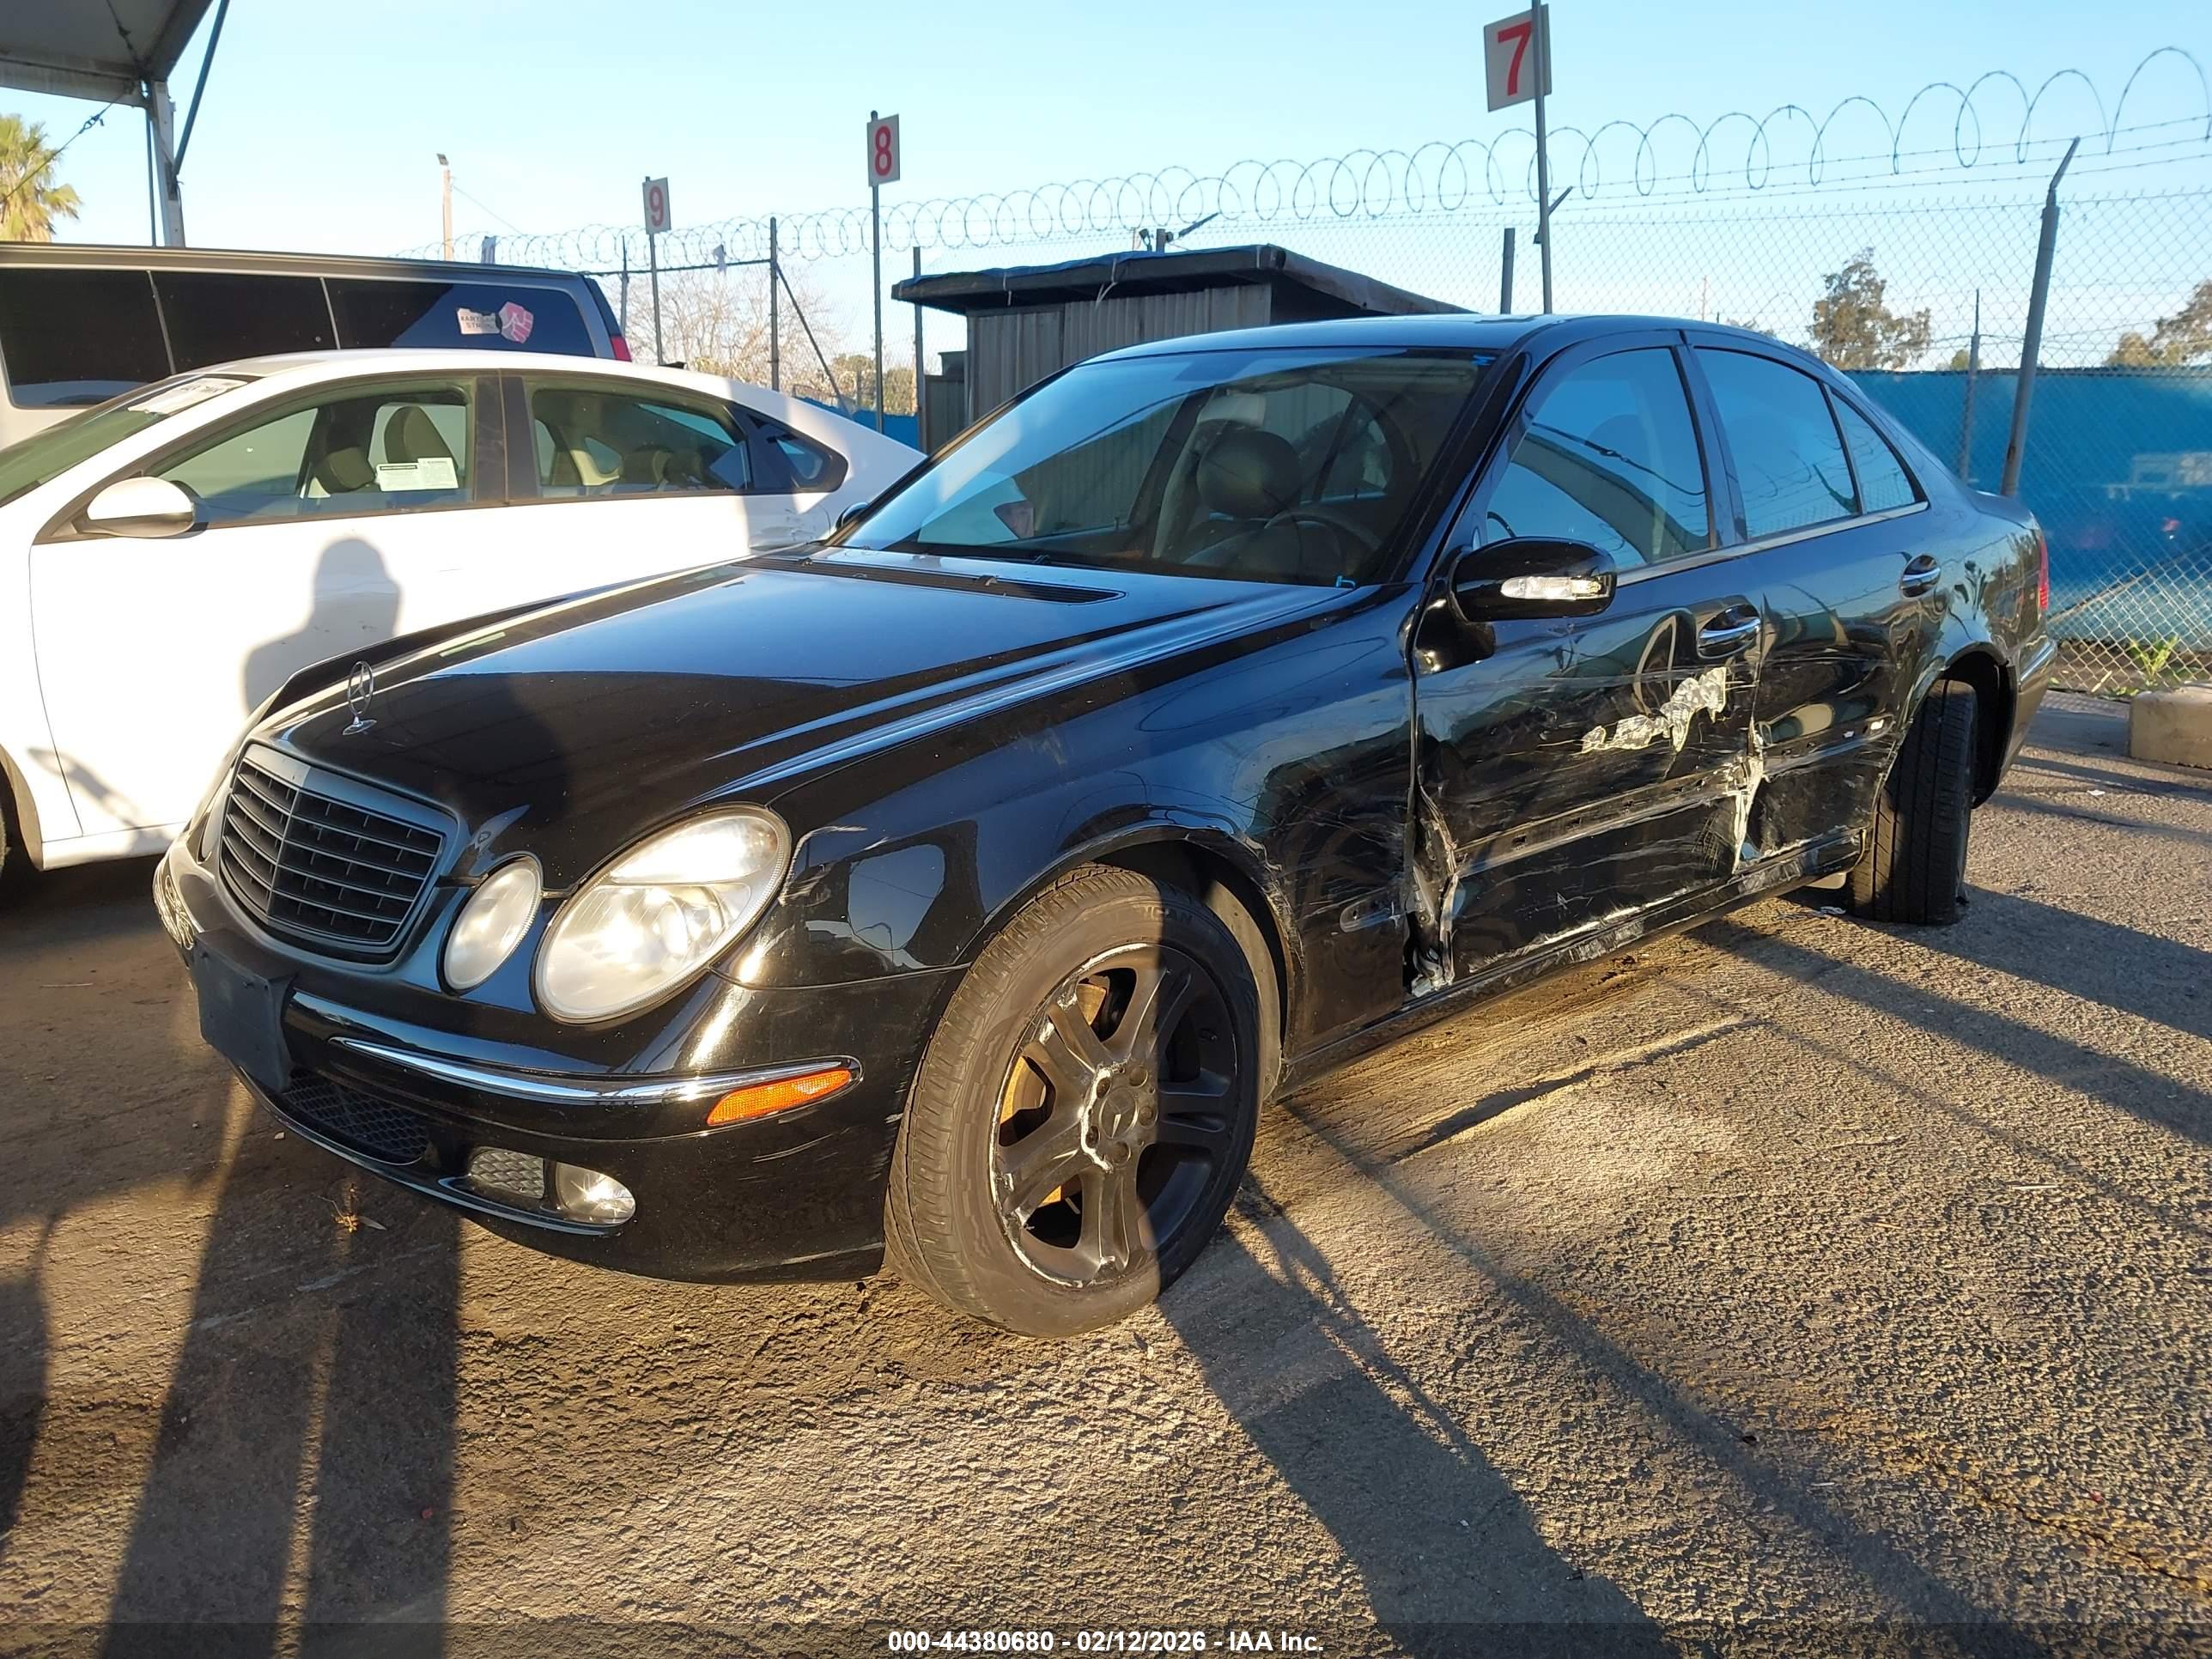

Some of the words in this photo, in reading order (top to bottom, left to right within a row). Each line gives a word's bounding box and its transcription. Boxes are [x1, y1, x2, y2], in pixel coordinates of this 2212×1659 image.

[1497, 20, 1532, 96] 7
[875, 125, 892, 176] 8
[649, 185, 664, 227] 9
